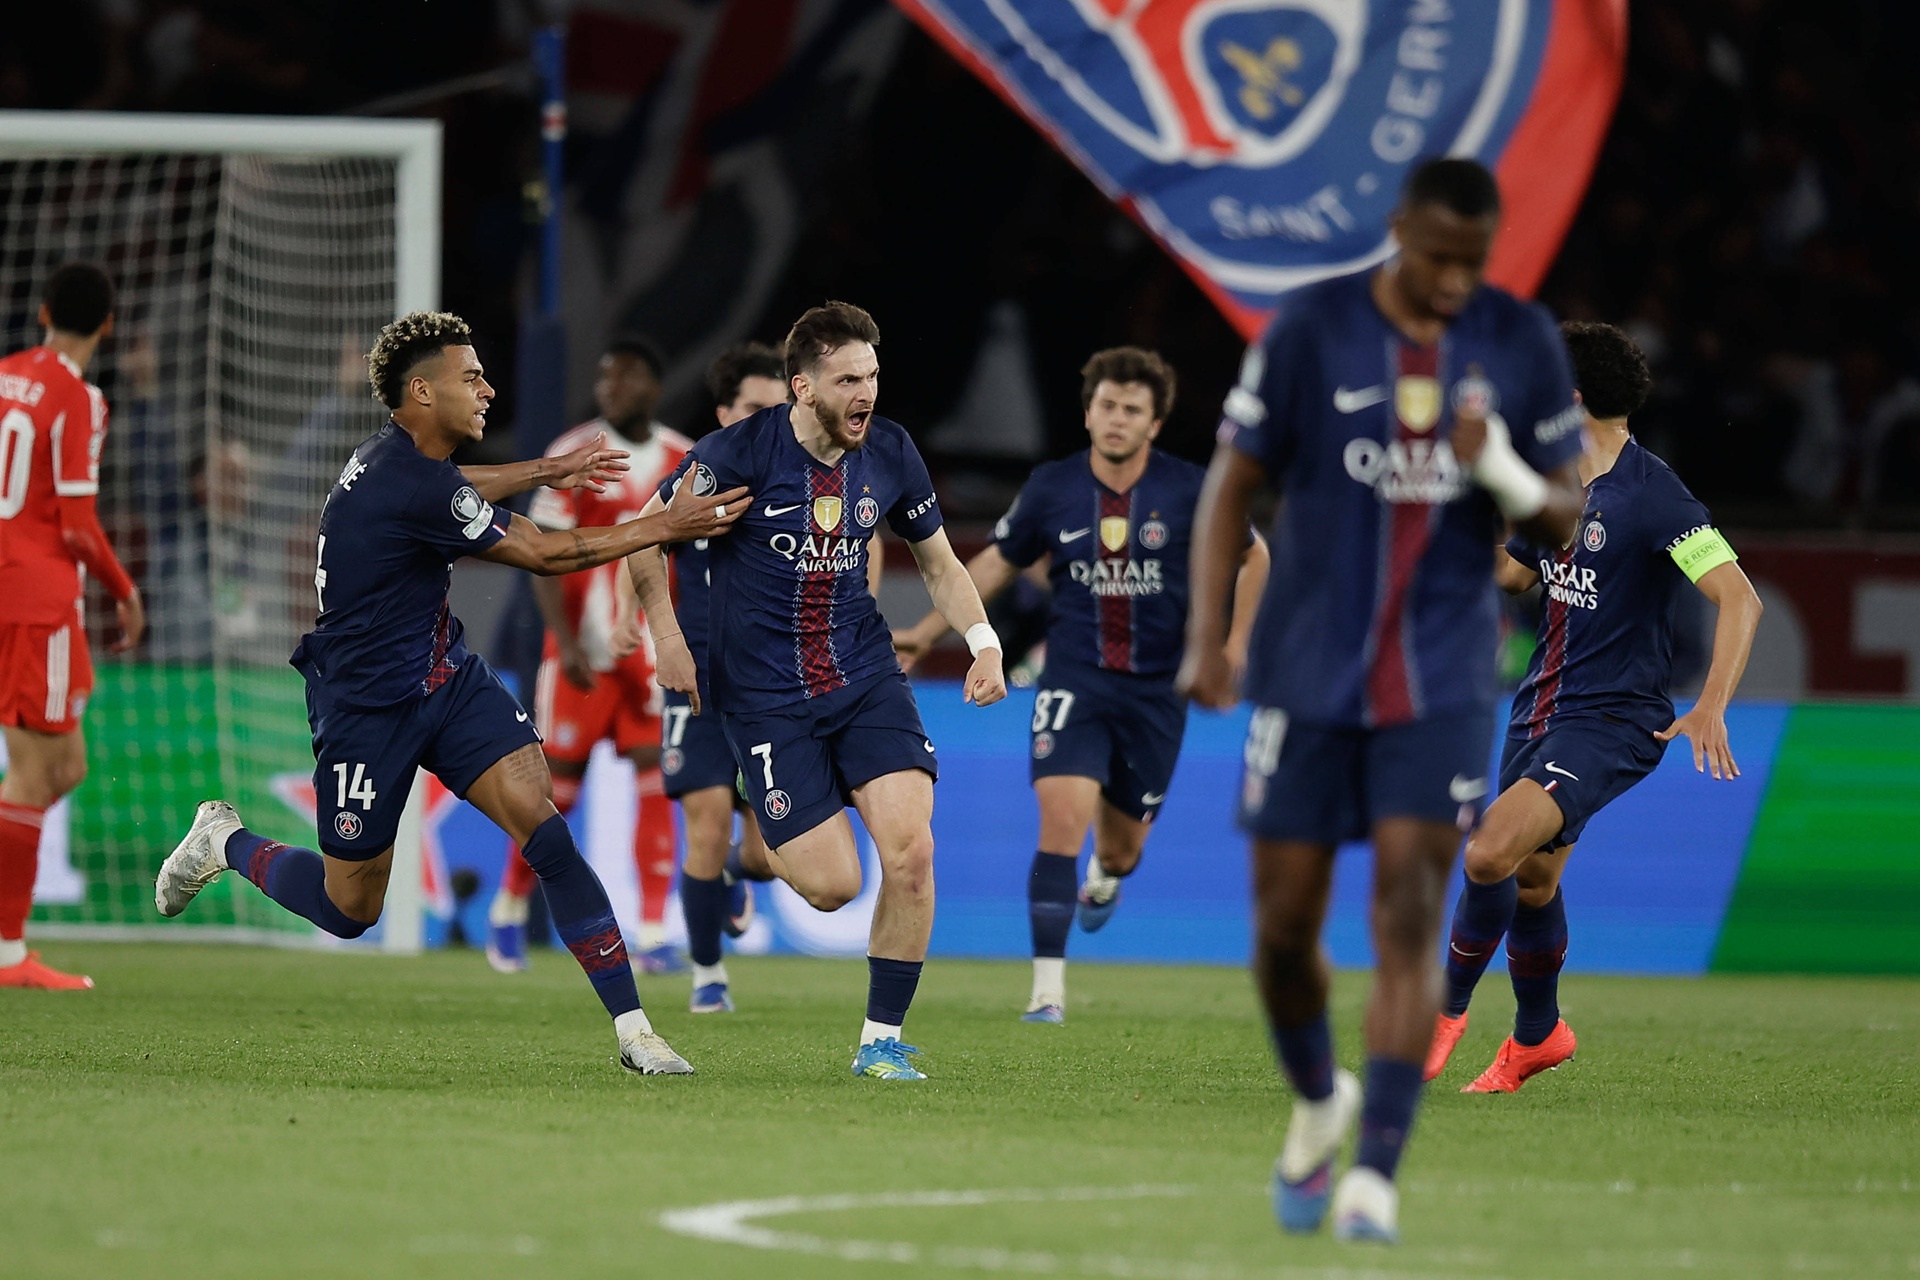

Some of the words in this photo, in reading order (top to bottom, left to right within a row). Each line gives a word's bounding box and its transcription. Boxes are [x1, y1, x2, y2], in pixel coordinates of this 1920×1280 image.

[770, 533, 863, 561] QATAR
[795, 553, 861, 572] AIRWAYS
[1069, 558, 1164, 586] QATAR
[1090, 581, 1164, 596] AIRWAYS
[1032, 688, 1076, 733] 87
[751, 742, 774, 790] 7
[333, 762, 377, 810] 14
